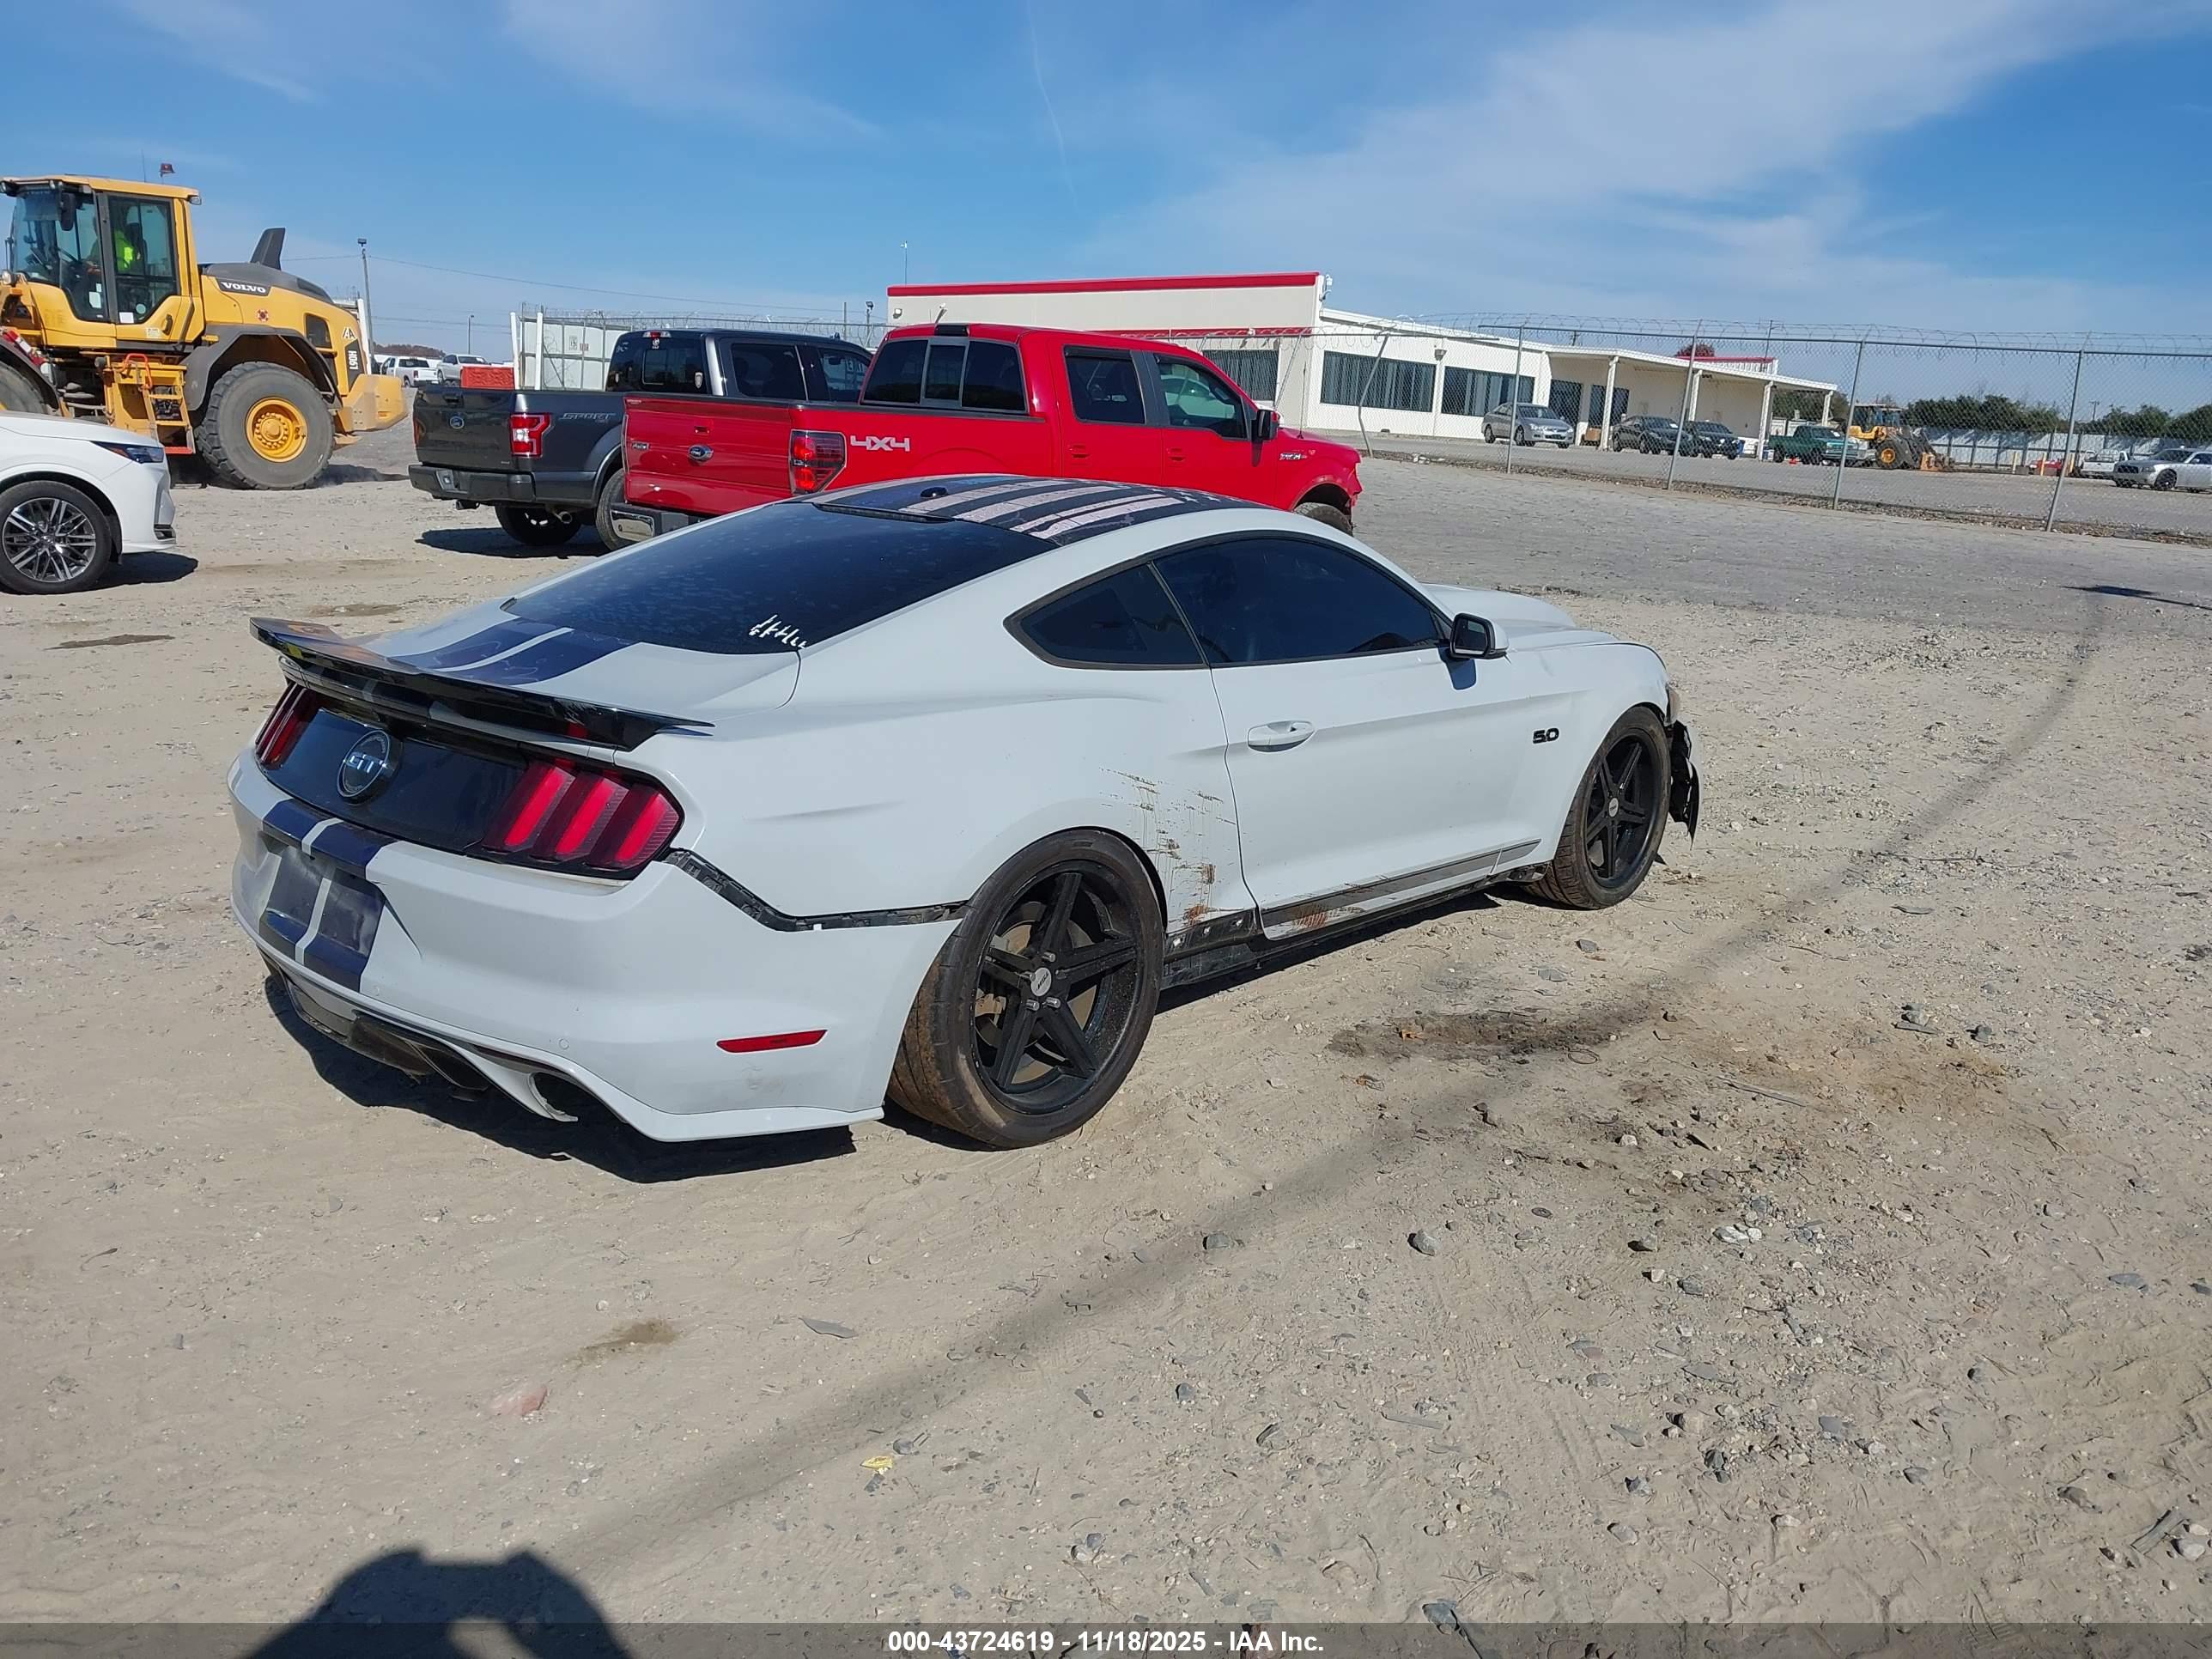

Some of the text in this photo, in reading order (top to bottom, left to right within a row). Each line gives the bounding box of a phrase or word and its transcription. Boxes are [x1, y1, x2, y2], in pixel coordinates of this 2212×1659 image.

[221, 282, 266, 294] VOLVO
[348, 350, 359, 370] L90H
[346, 751, 384, 773] GT
